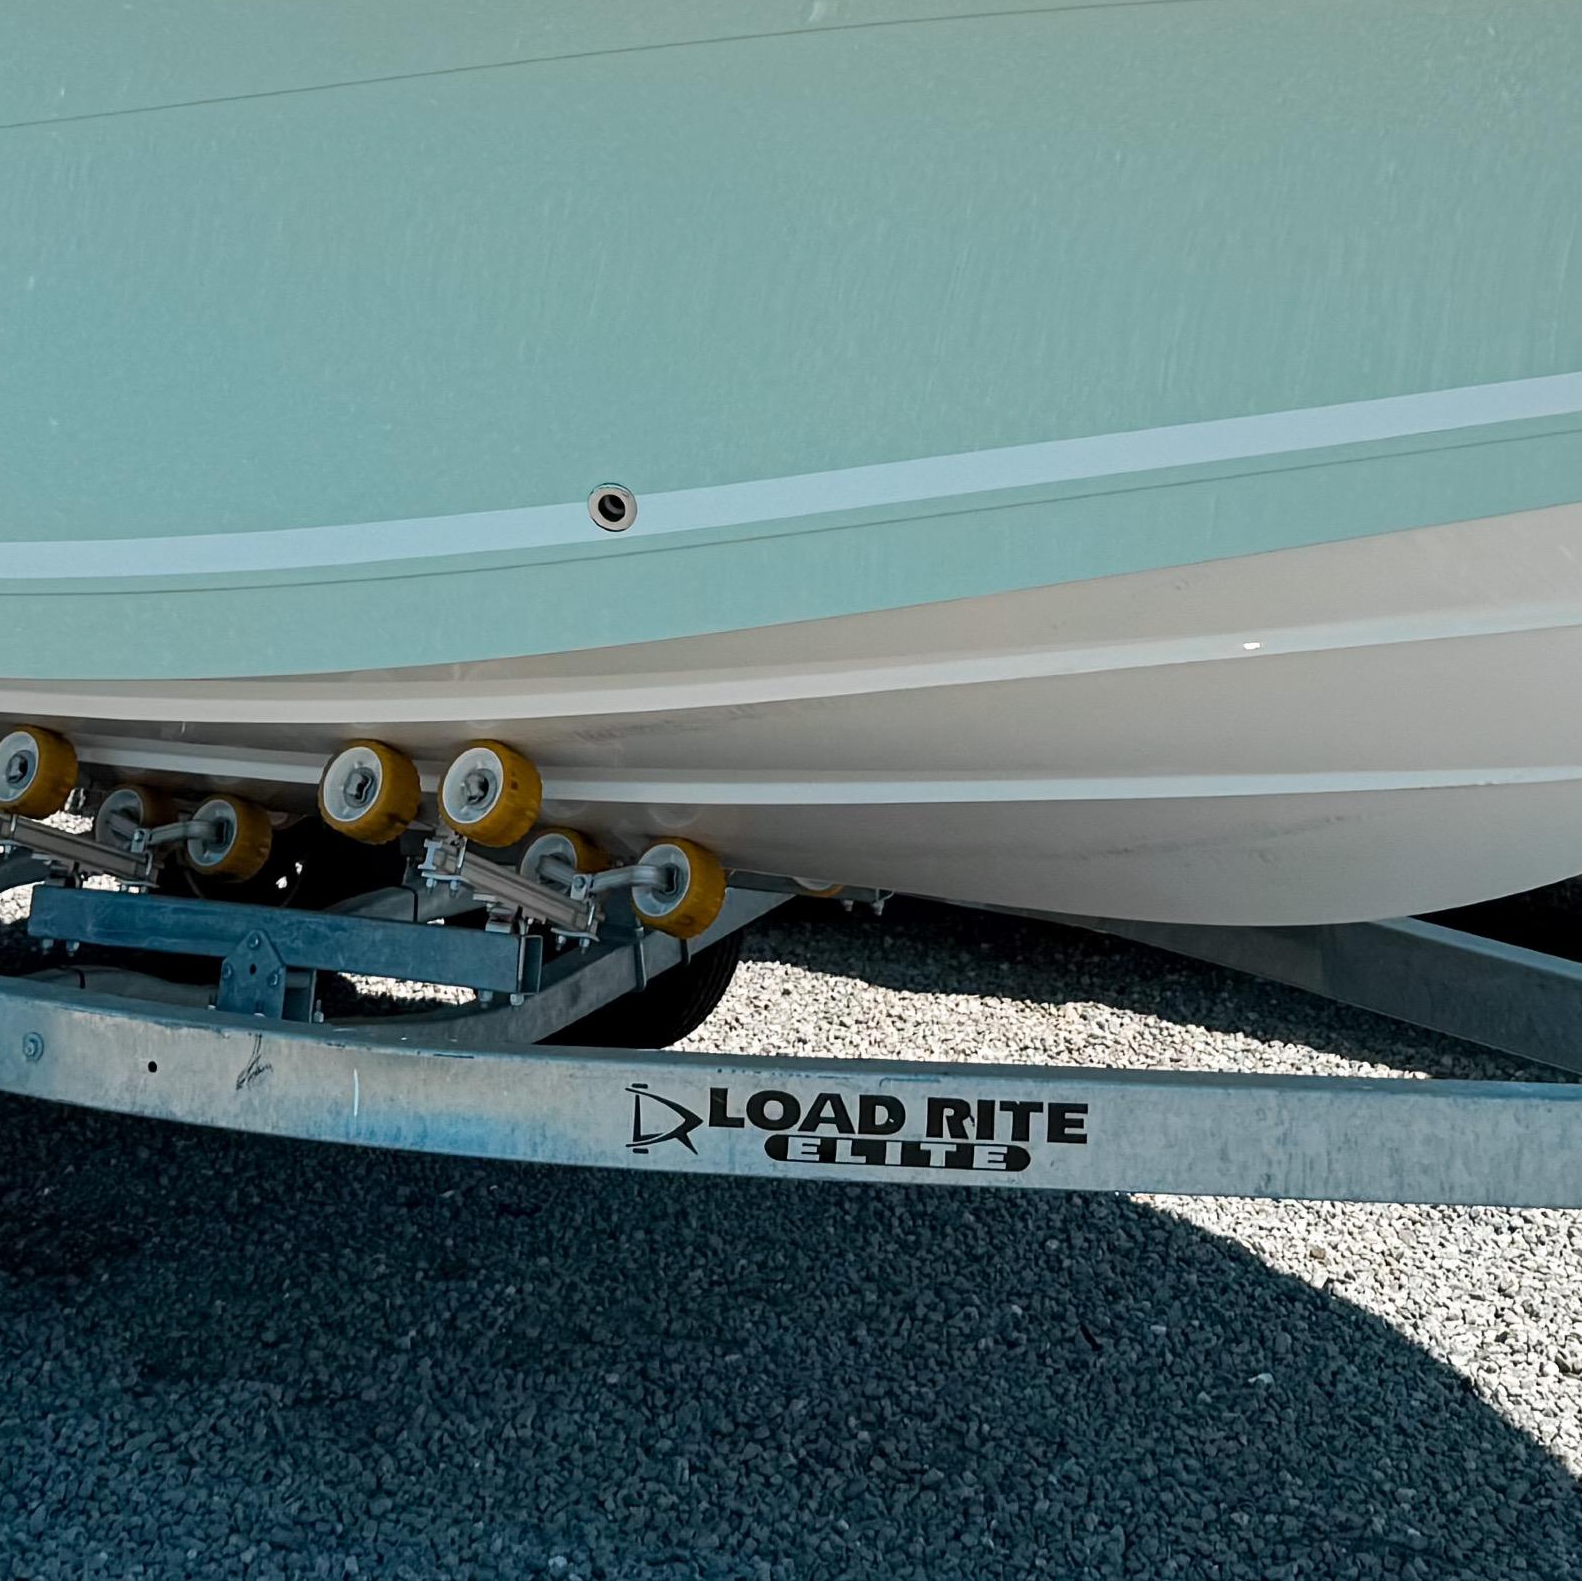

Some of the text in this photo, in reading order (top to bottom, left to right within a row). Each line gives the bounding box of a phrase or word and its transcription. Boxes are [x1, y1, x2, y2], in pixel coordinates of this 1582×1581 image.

[709, 1087, 1089, 1144] LOAD RITE
[787, 1136, 1009, 1170] ELITE
